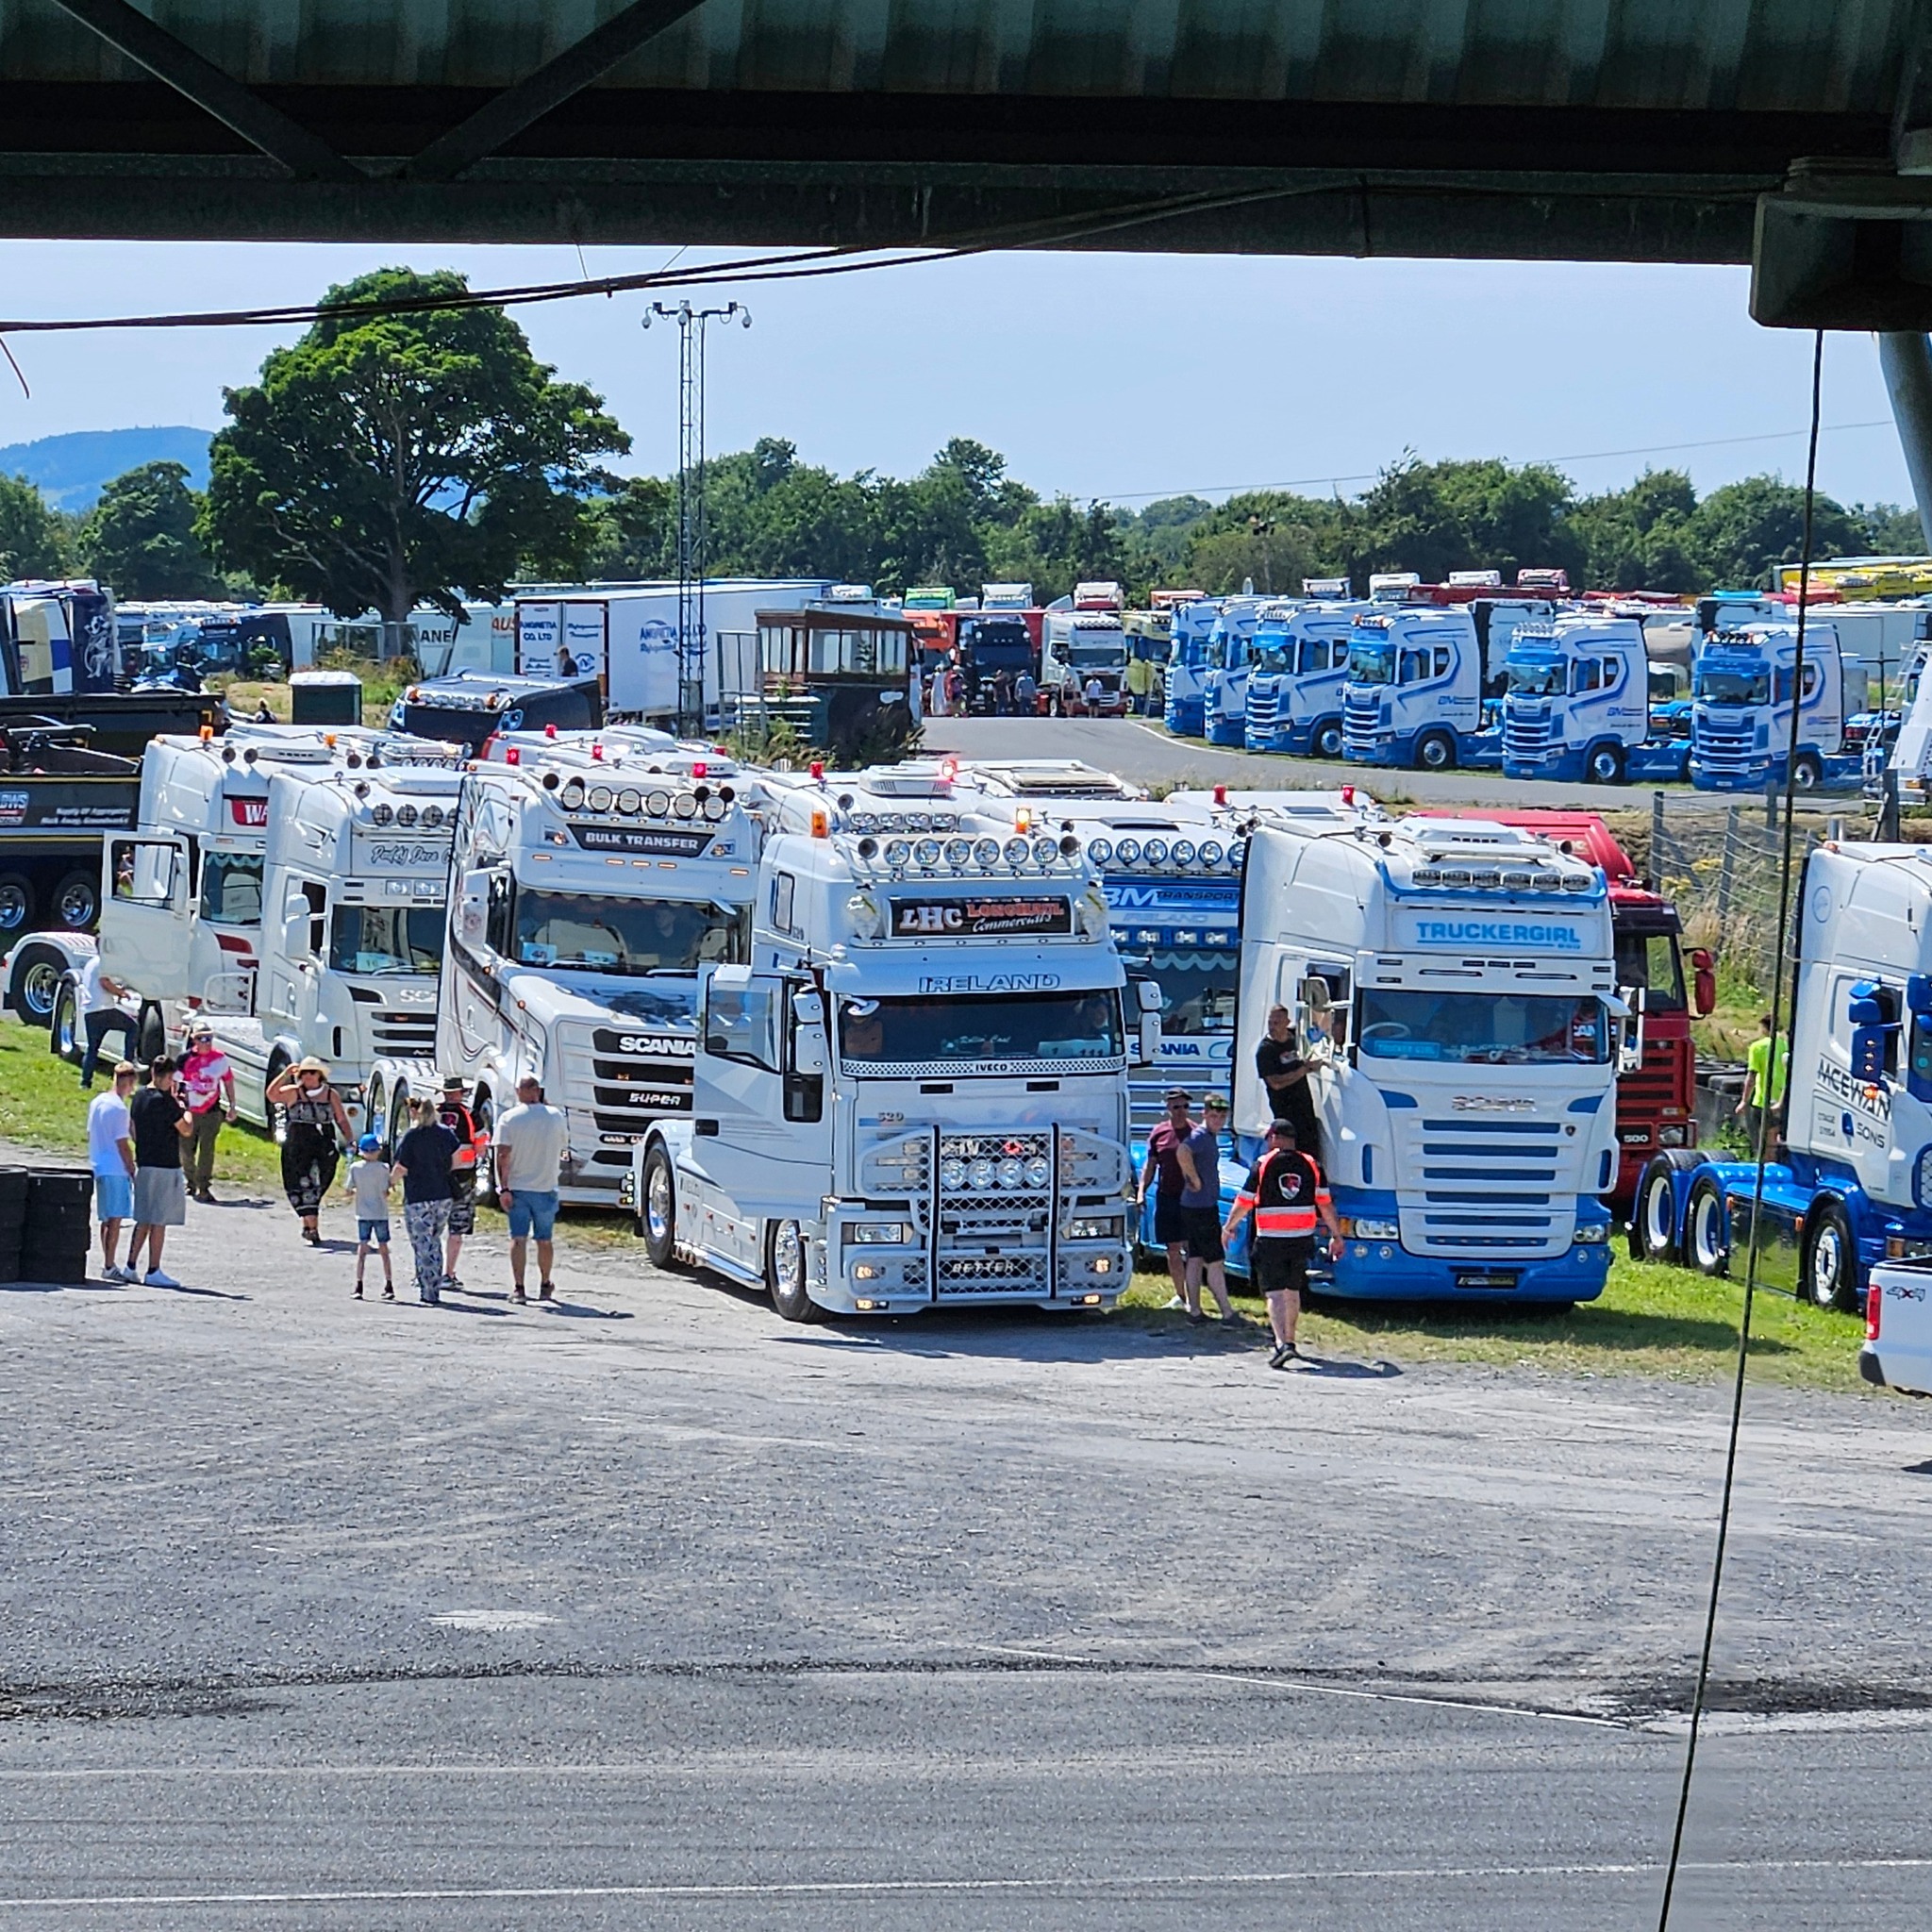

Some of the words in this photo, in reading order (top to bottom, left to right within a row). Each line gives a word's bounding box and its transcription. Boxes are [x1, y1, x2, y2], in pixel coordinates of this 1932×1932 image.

[585, 832, 621, 845] BULK
[625, 835, 699, 849] TRANSFER
[1104, 888, 1160, 907] BM
[899, 906, 963, 931] LHC
[1416, 922, 1581, 943] TRUCKERGIRL
[919, 974, 1061, 993] IRELAND
[619, 1037, 696, 1056] SCANIA
[975, 1063, 1008, 1072] IVECO
[629, 1092, 681, 1106] SUPER
[1624, 1134, 1649, 1143] 500
[1857, 1122, 1886, 1149] SONS
